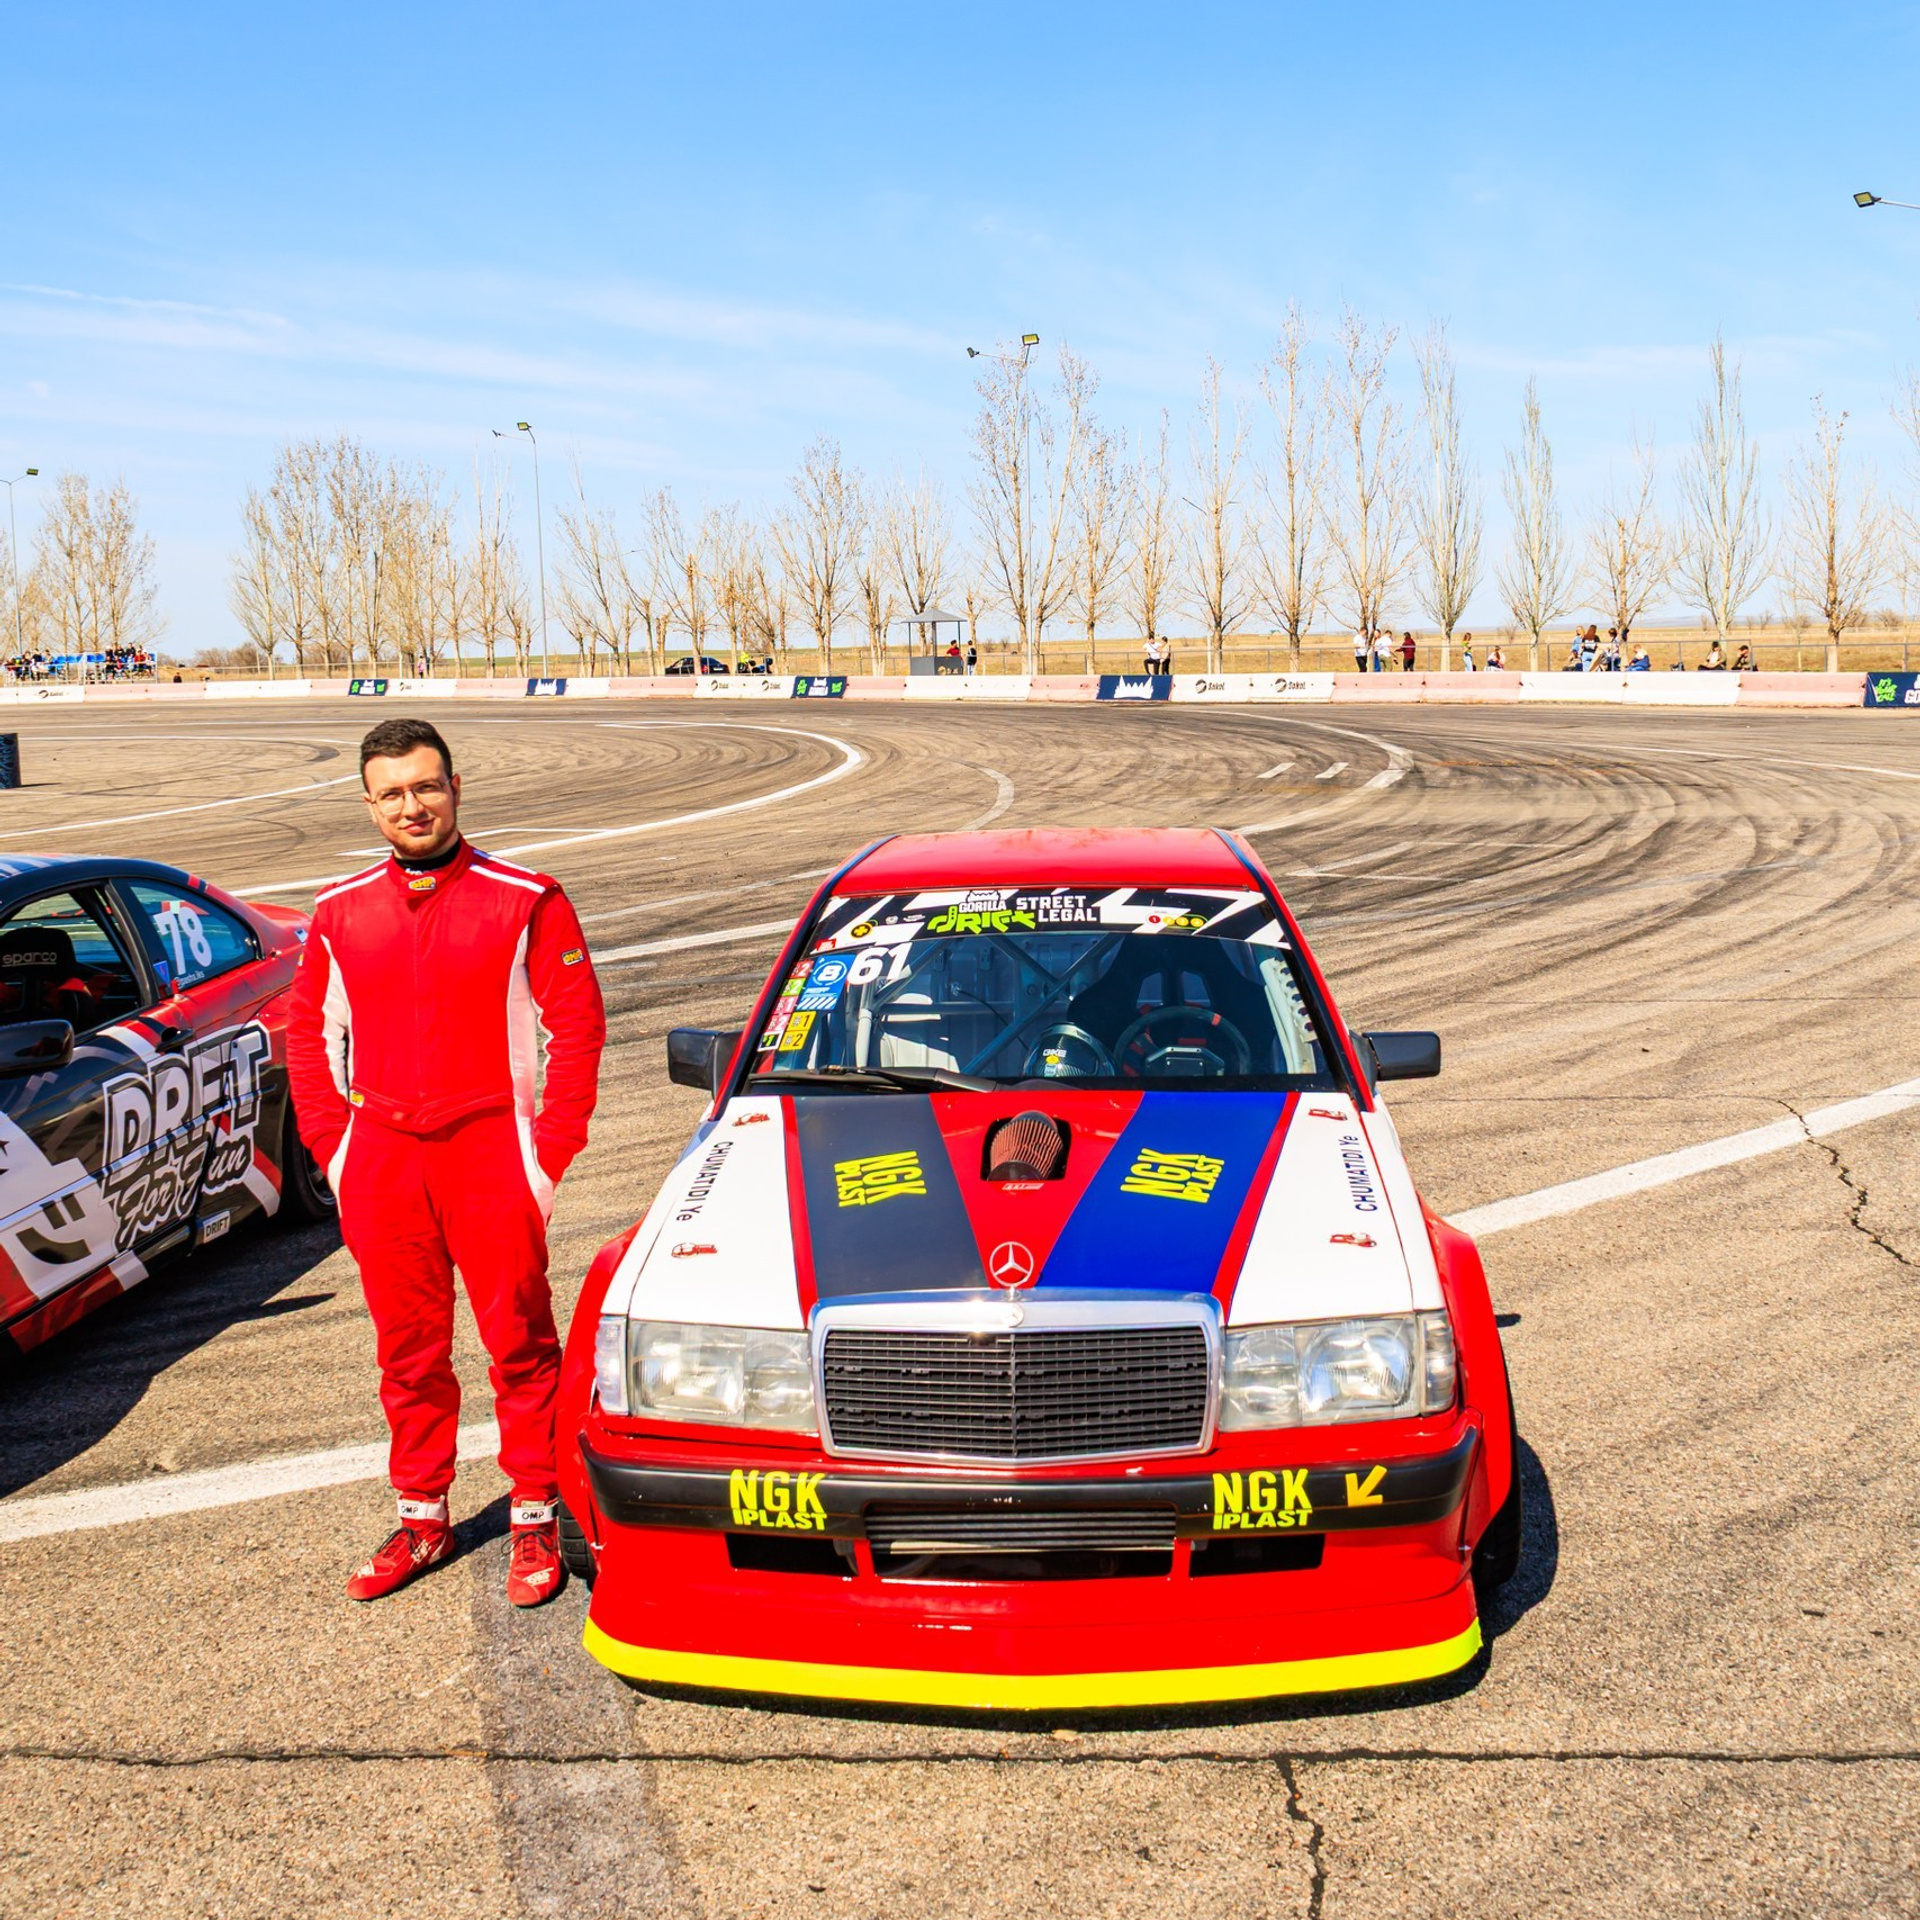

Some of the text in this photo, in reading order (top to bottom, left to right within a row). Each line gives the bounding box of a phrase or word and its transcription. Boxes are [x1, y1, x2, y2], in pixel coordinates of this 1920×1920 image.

[959, 900, 1007, 913] GORILLA
[1016, 895, 1087, 910] STREET
[1038, 908, 1097, 922] LEGAL
[153, 906, 212, 975] 78
[2, 951, 57, 967] sparco
[847, 942, 913, 985] 61
[816, 965, 843, 981] 8
[803, 1014, 811, 1028] 1
[792, 1033, 803, 1047] 2
[676, 1141, 734, 1221] CHUMATIDI Ye
[859, 1150, 927, 1204] NGK
[1120, 1148, 1200, 1197] NGK
[1338, 1135, 1378, 1212] CHUMATIDI Ye
[205, 1215, 229, 1238] DRIFT
[730, 1469, 826, 1513] NGK
[1212, 1468, 1312, 1514] NGK
[401, 1505, 419, 1514] OMP
[521, 1511, 545, 1520] OMP
